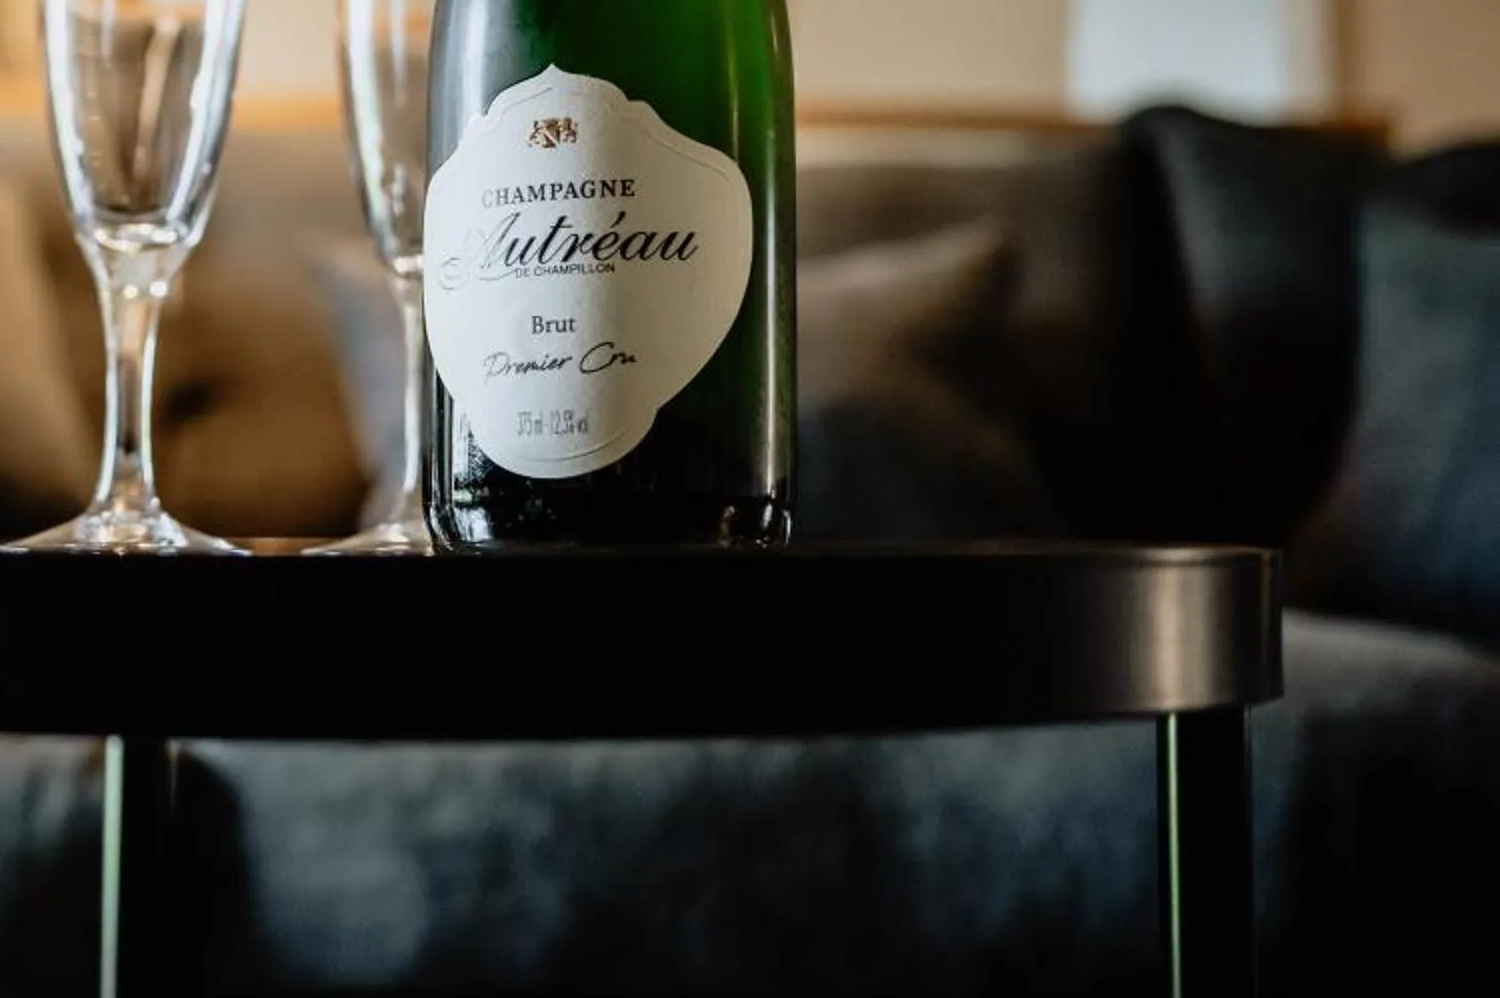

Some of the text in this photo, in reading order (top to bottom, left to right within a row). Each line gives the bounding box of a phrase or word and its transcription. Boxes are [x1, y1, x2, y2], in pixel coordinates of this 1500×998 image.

[480, 178, 636, 208] CHAMPAGNE
[439, 210, 699, 289] Autréau
[514, 262, 616, 279] DE CHAMPILLON
[531, 315, 577, 335] Brut
[483, 351, 573, 385] Premier
